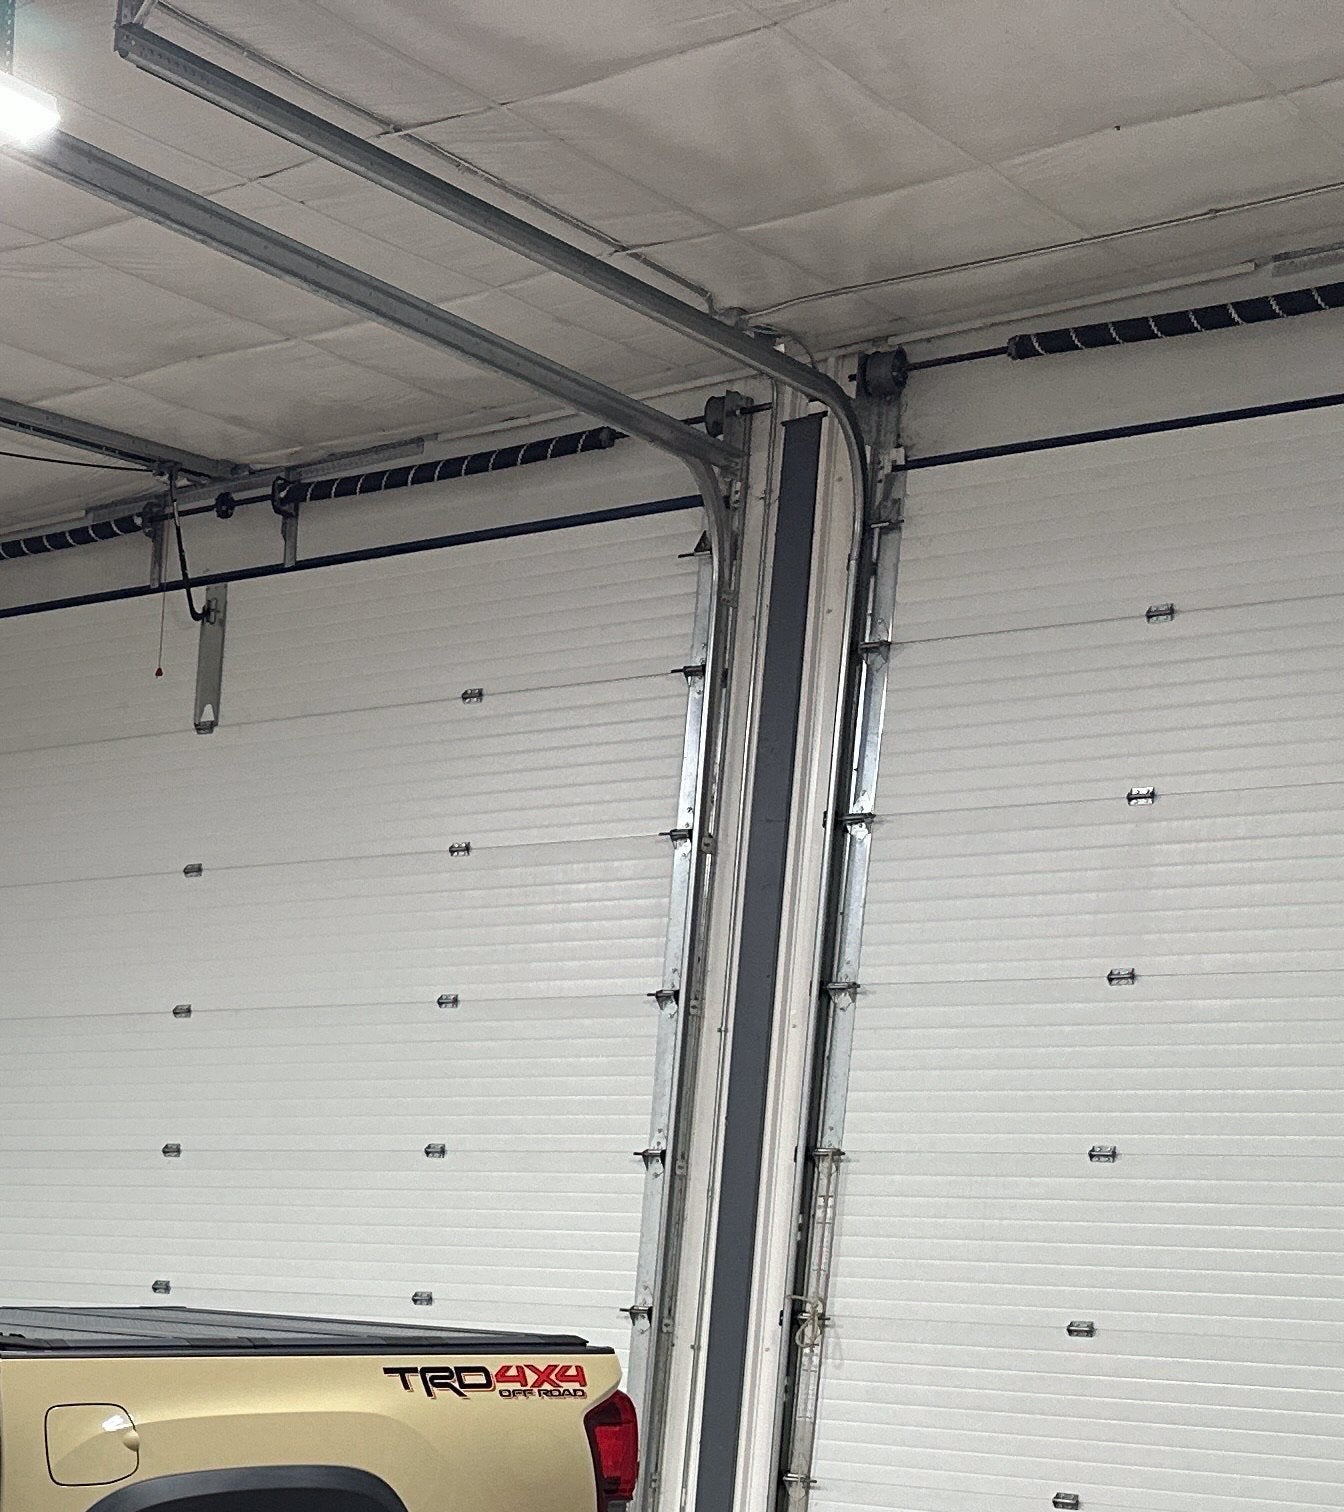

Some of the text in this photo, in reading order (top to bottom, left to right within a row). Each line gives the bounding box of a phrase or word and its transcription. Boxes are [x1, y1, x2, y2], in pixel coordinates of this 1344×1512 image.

[383, 1366, 496, 1399] TRD
[499, 1389, 587, 1398] OFF ROAD
